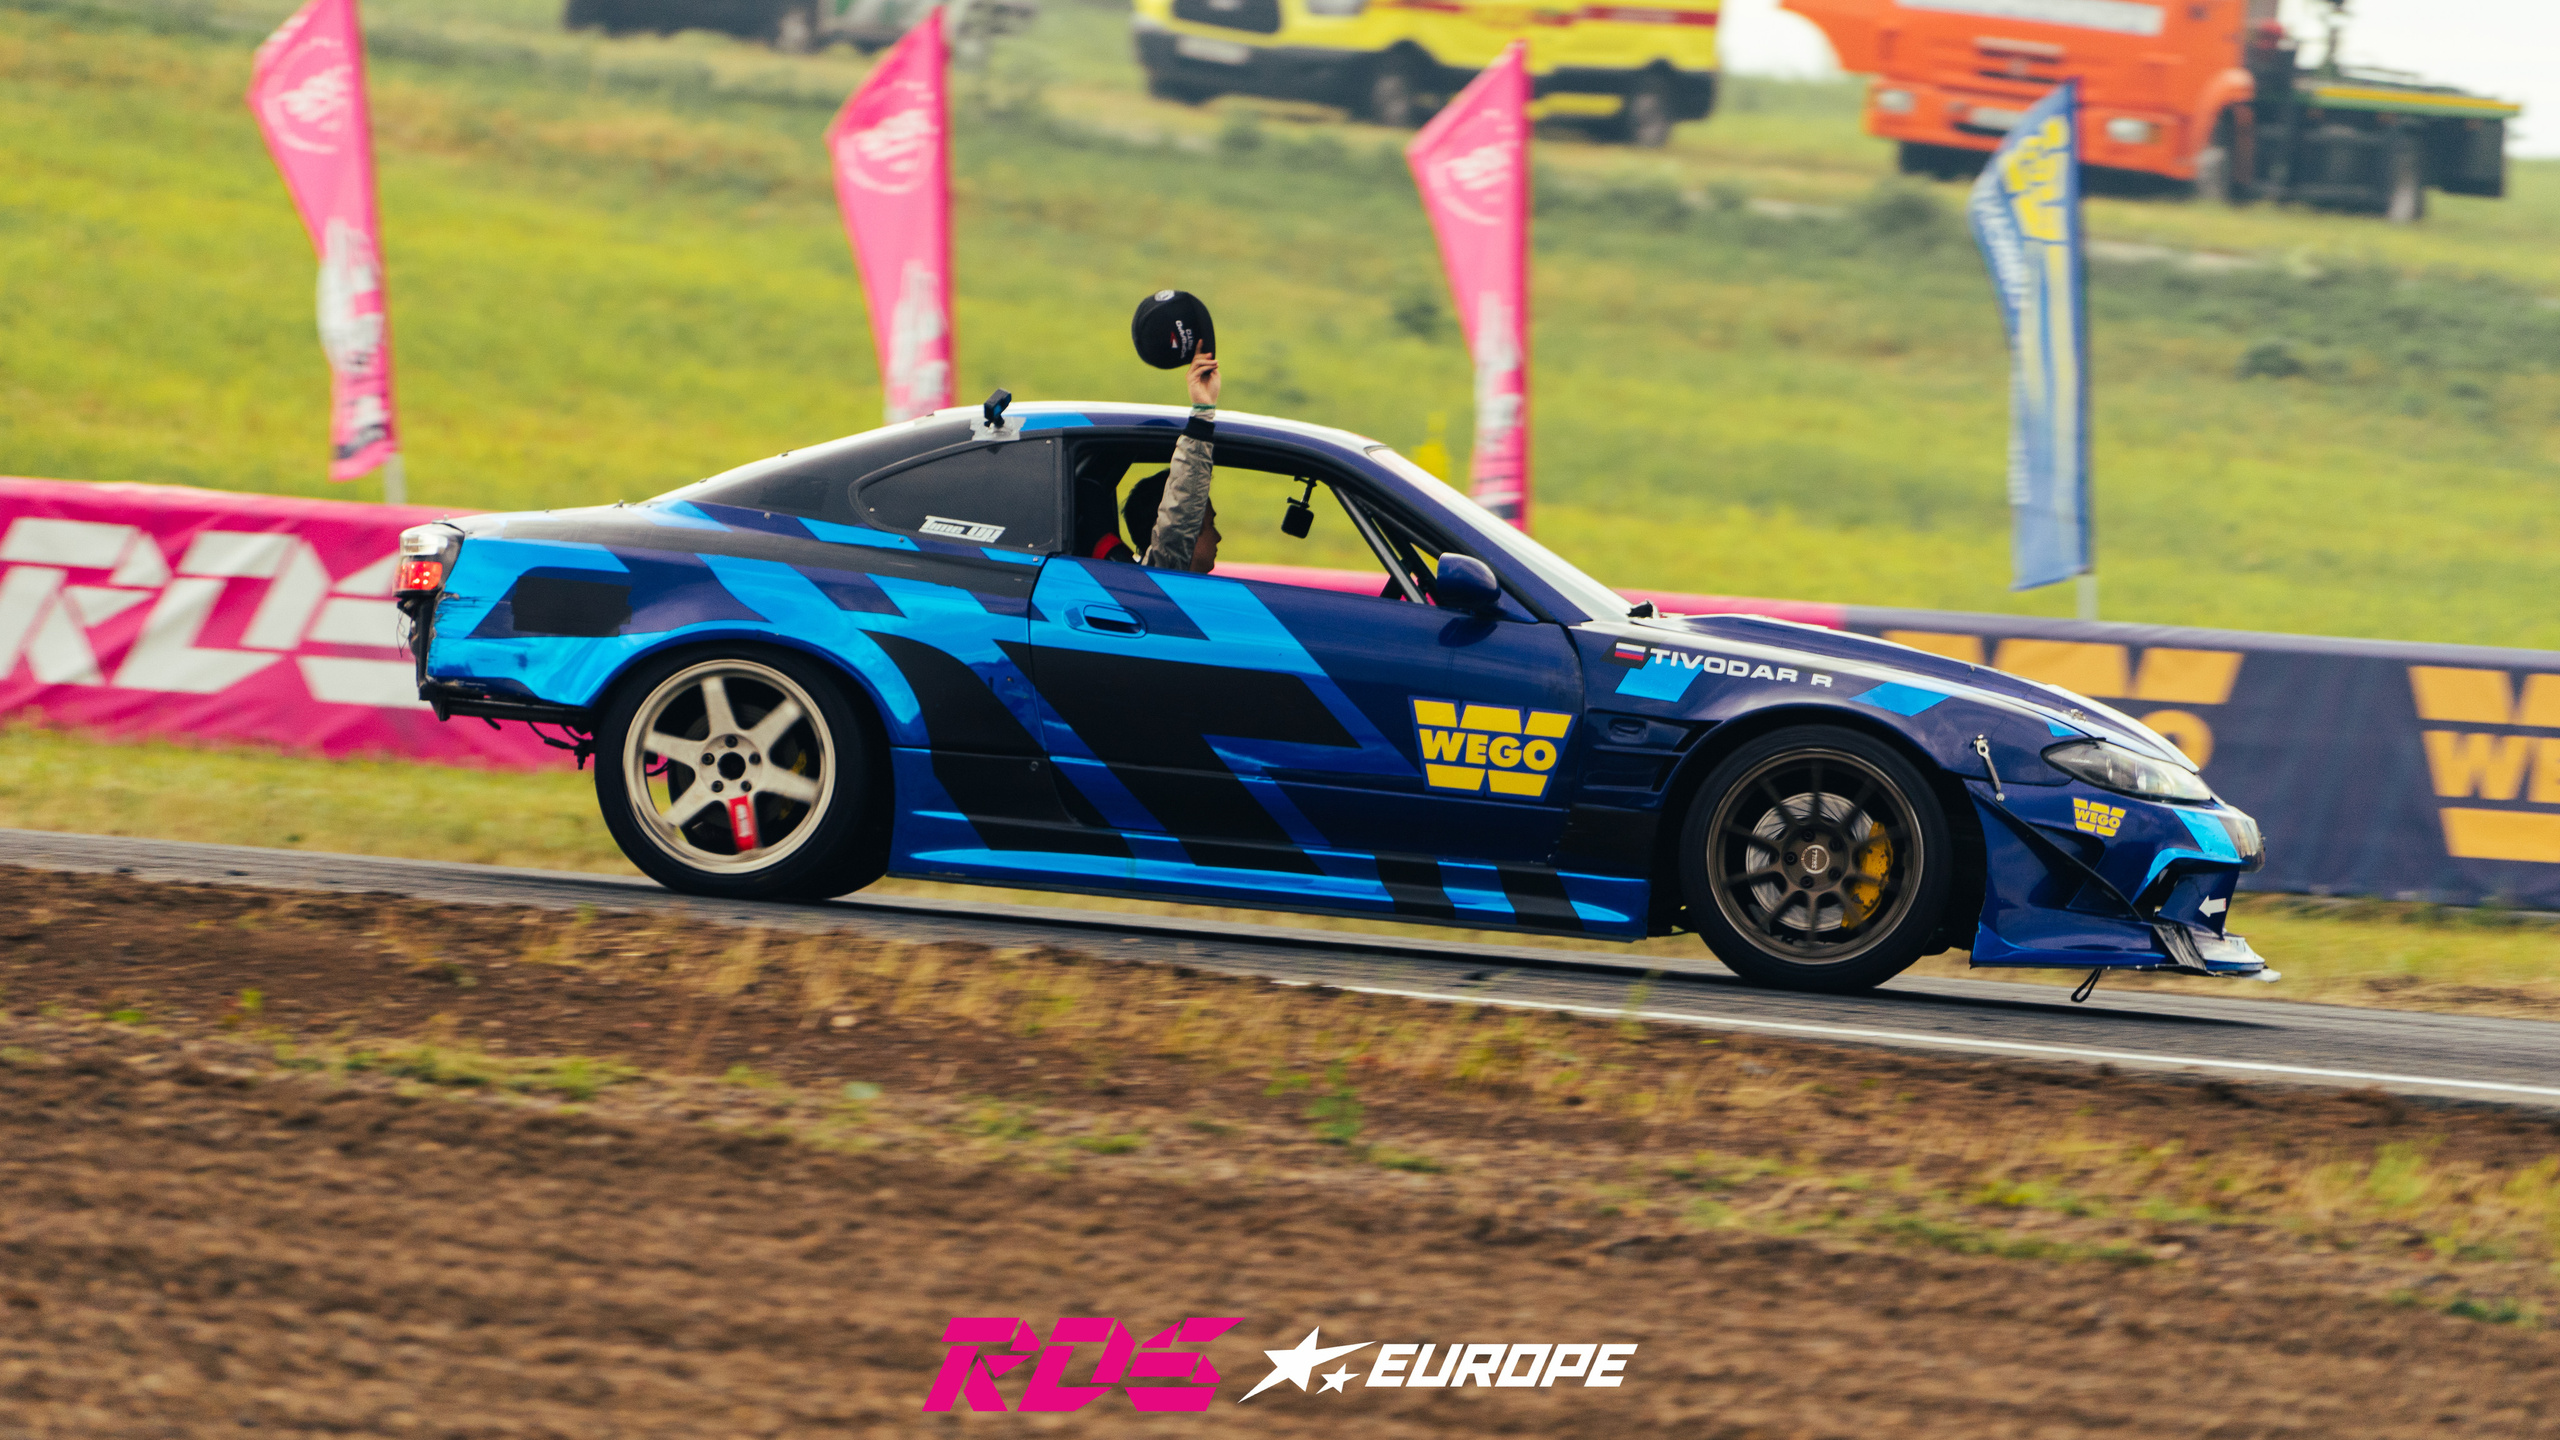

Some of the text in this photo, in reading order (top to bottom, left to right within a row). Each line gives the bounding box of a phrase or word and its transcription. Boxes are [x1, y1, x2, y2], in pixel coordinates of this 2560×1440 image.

[1650, 648, 1834, 688] TIVODAR R
[1418, 728, 1557, 772] WEGO
[2074, 807, 2121, 829] WEGO
